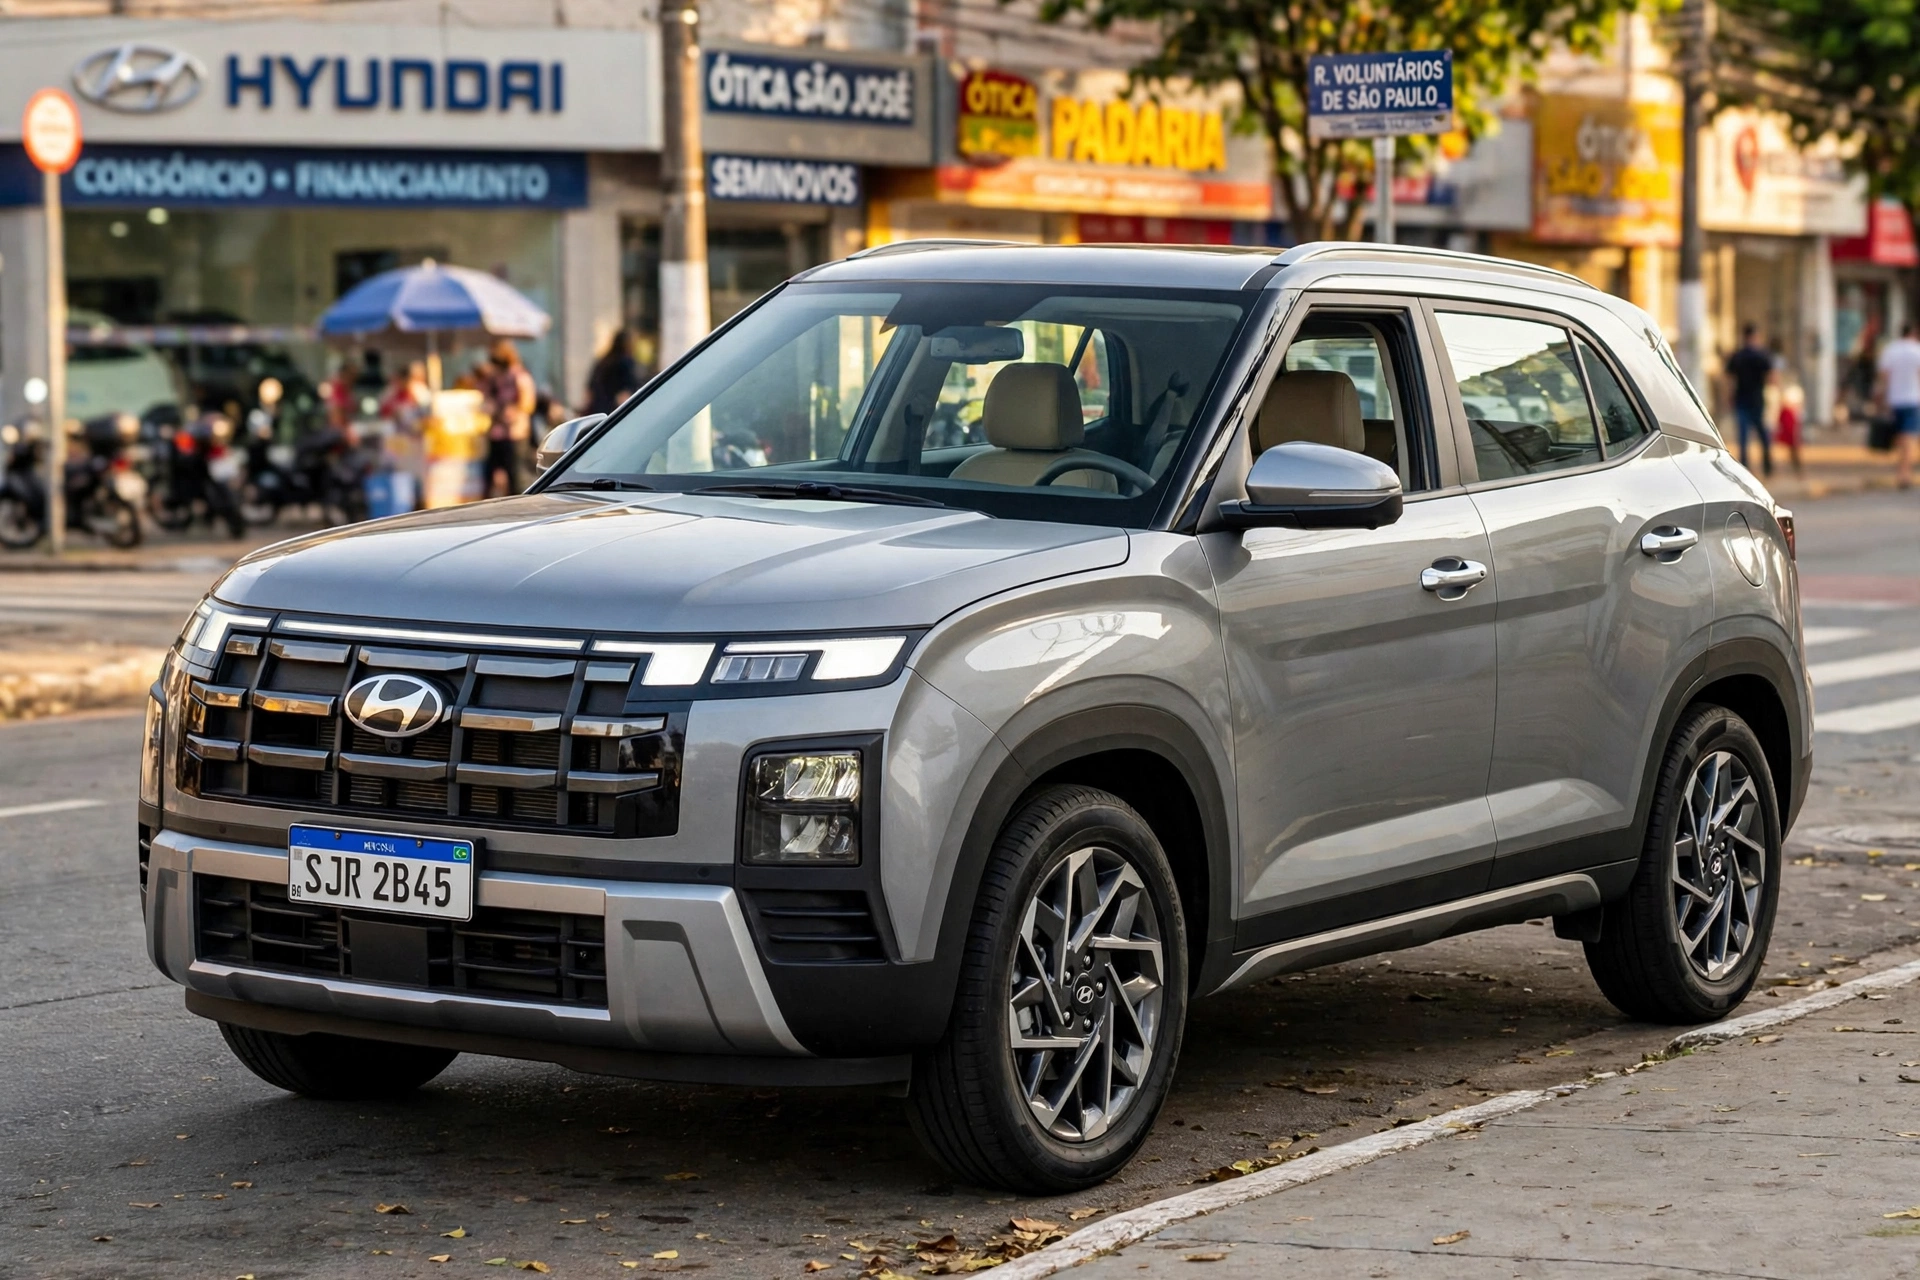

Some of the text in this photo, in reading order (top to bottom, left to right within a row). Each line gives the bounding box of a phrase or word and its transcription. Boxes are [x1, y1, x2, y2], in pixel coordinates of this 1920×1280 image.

[226, 55, 563, 113] HYUNDAI
[709, 54, 911, 119] ÓTICA SÃO JOSÉ
[1314, 57, 1444, 85] R. VOLUNTÁRIOS
[1322, 85, 1438, 111] DE SÃO PAULO
[1051, 96, 1227, 172] PADARIA
[74, 152, 549, 200] CONSÓRCIO FINANCIAMENTO
[712, 156, 857, 203] SEMINOVOS
[305, 853, 452, 907] SJR 2B45
